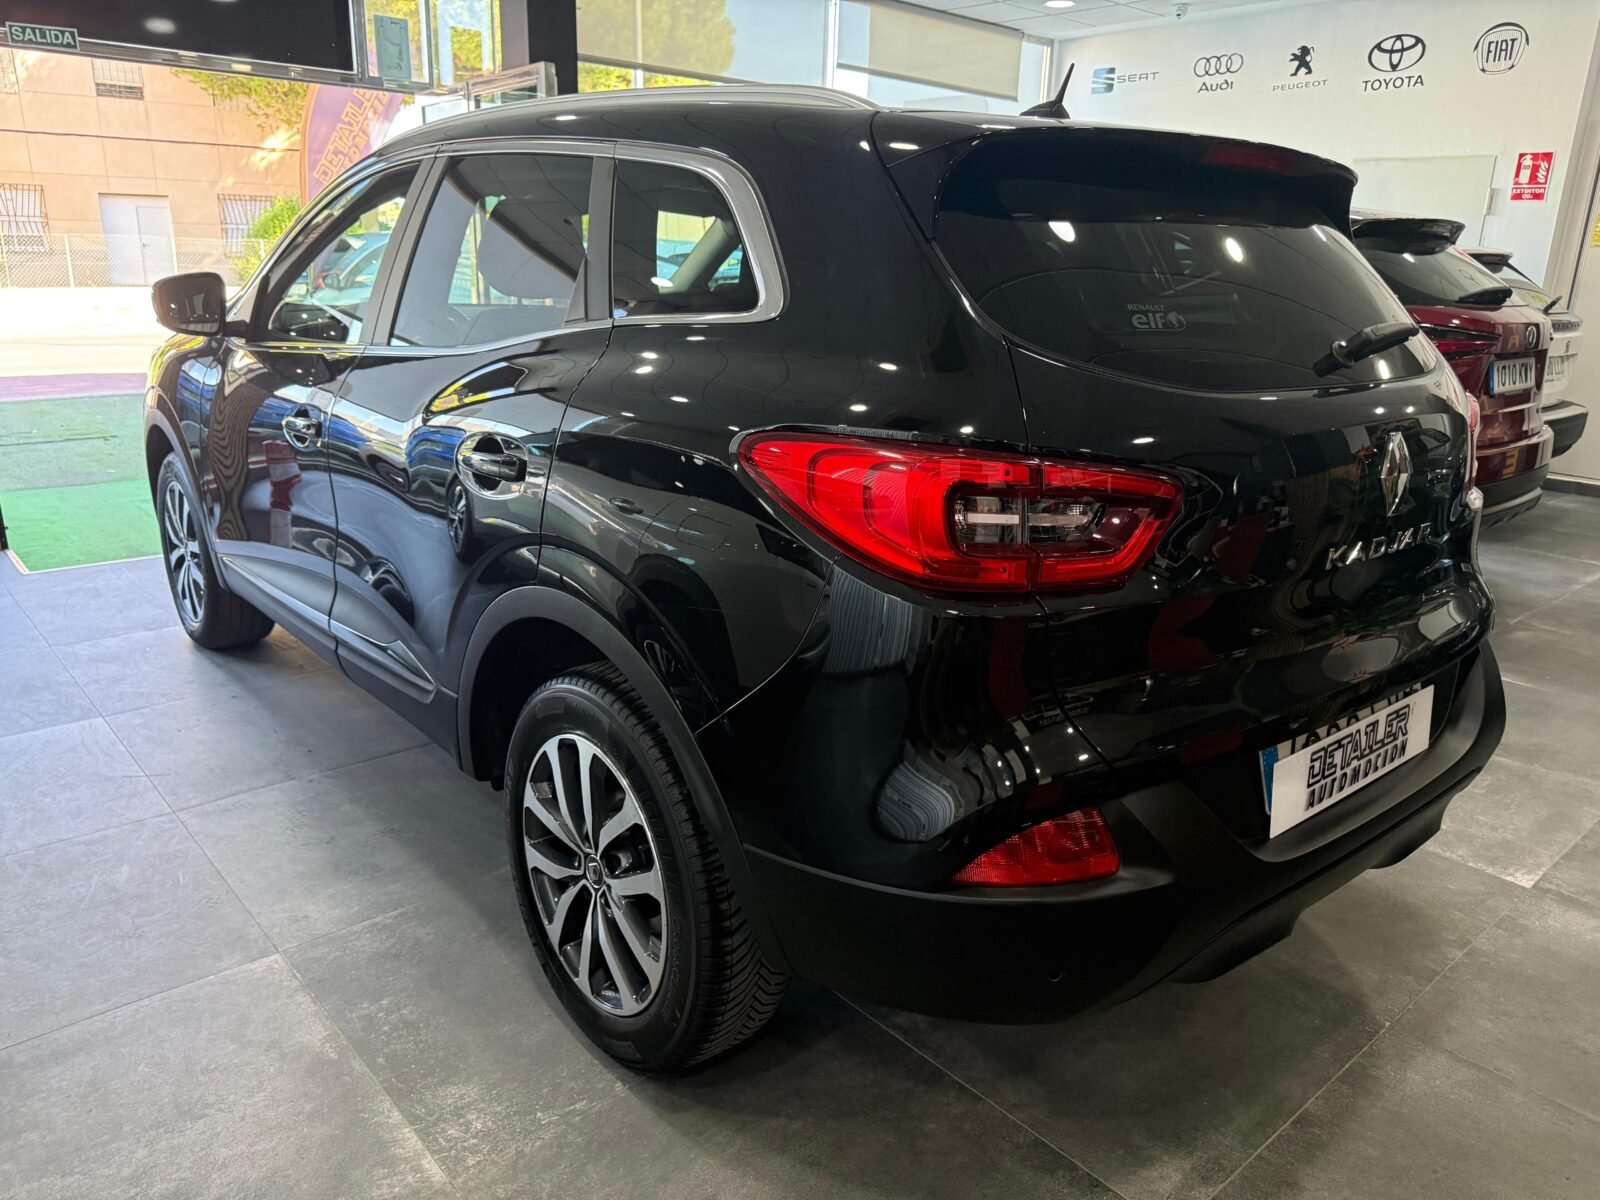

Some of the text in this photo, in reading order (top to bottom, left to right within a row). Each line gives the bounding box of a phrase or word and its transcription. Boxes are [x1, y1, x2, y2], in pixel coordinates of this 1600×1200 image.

[1485, 37, 1519, 64] FIAT
[1116, 71, 1160, 84] SEAT
[1197, 79, 1234, 94] Audi
[1272, 79, 1328, 92] PEUGEOT
[1362, 75, 1425, 92] TOYOTA
[313, 88, 377, 185] DETAILE
[1127, 303, 1165, 312] RENAULT
[1131, 312, 1165, 329] elf
[1496, 363, 1517, 388] 1010
[1325, 522, 1432, 571] KADJAR
[1307, 703, 1411, 789] DETAILER
[1304, 737, 1408, 811] AUTOMOCION
